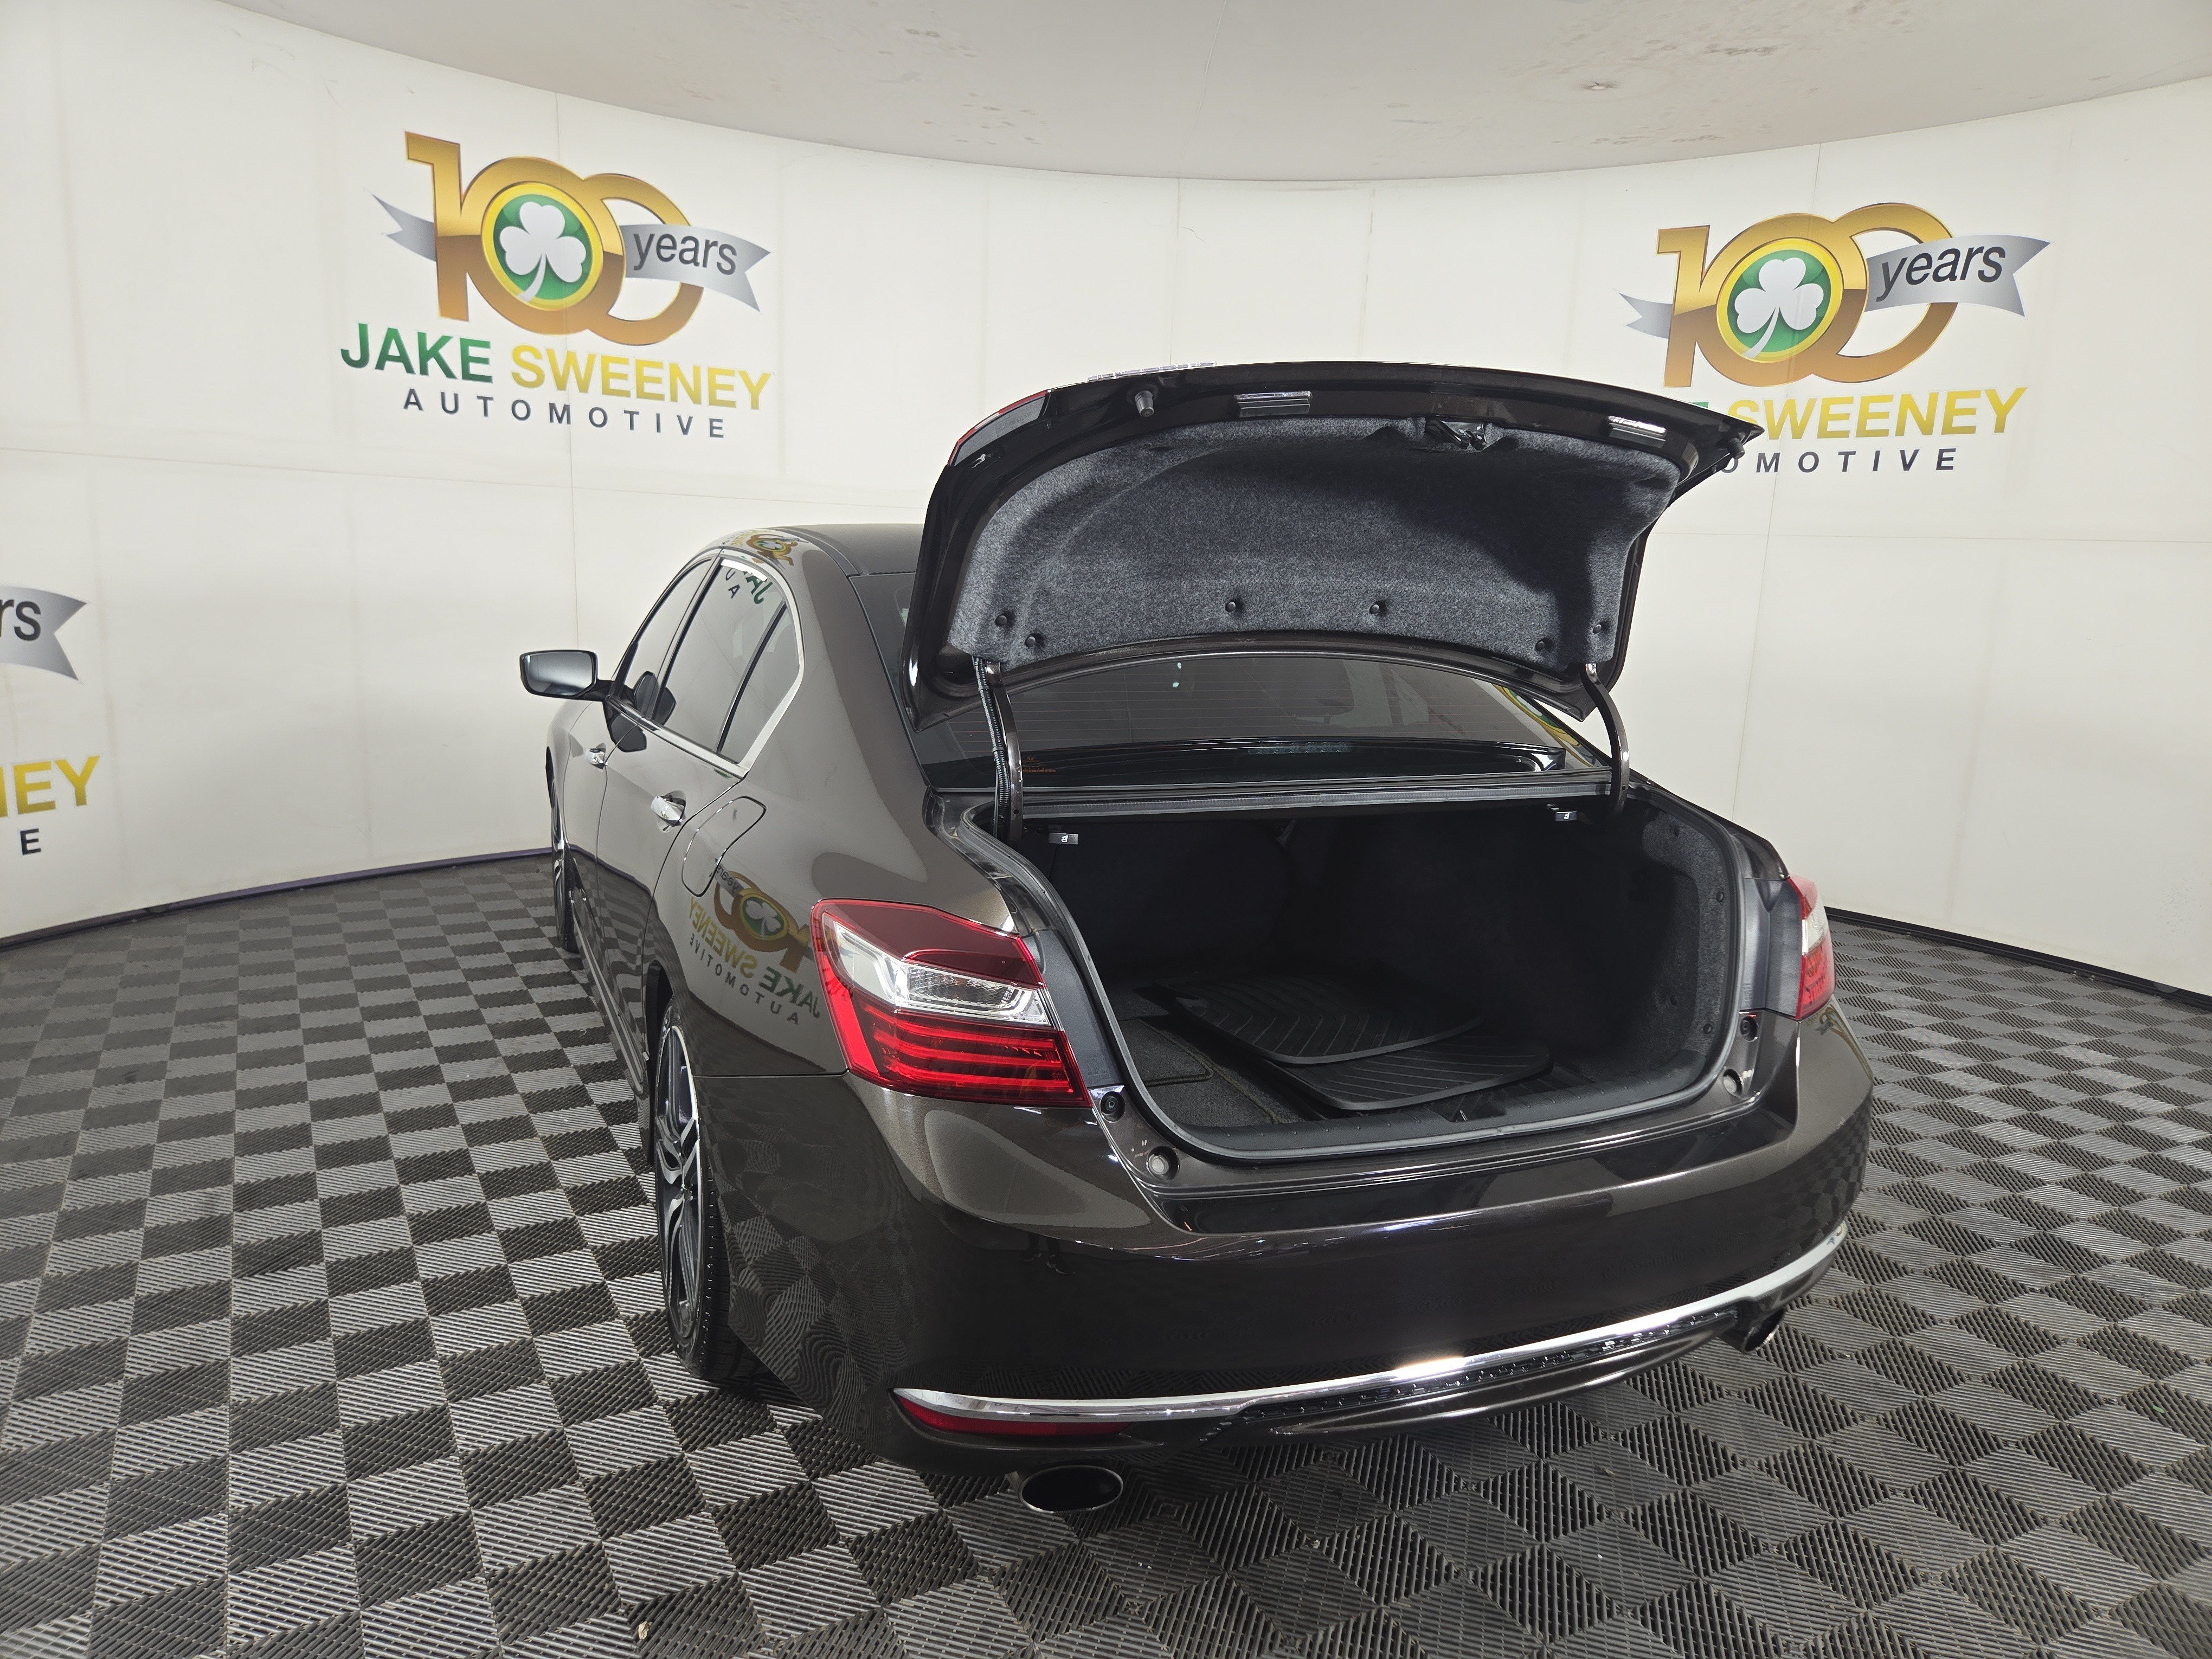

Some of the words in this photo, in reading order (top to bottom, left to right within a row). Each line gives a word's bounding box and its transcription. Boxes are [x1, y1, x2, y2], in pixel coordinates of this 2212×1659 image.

[404, 131, 704, 346] 100
[633, 230, 738, 275] years
[1657, 202, 1958, 388] 100
[1875, 245, 2005, 302] years
[340, 323, 493, 384] JAKE
[511, 345, 773, 410] SWEENEY
[403, 388, 724, 439] AUTOMOTIVE
[0, 755, 100, 818] EY
